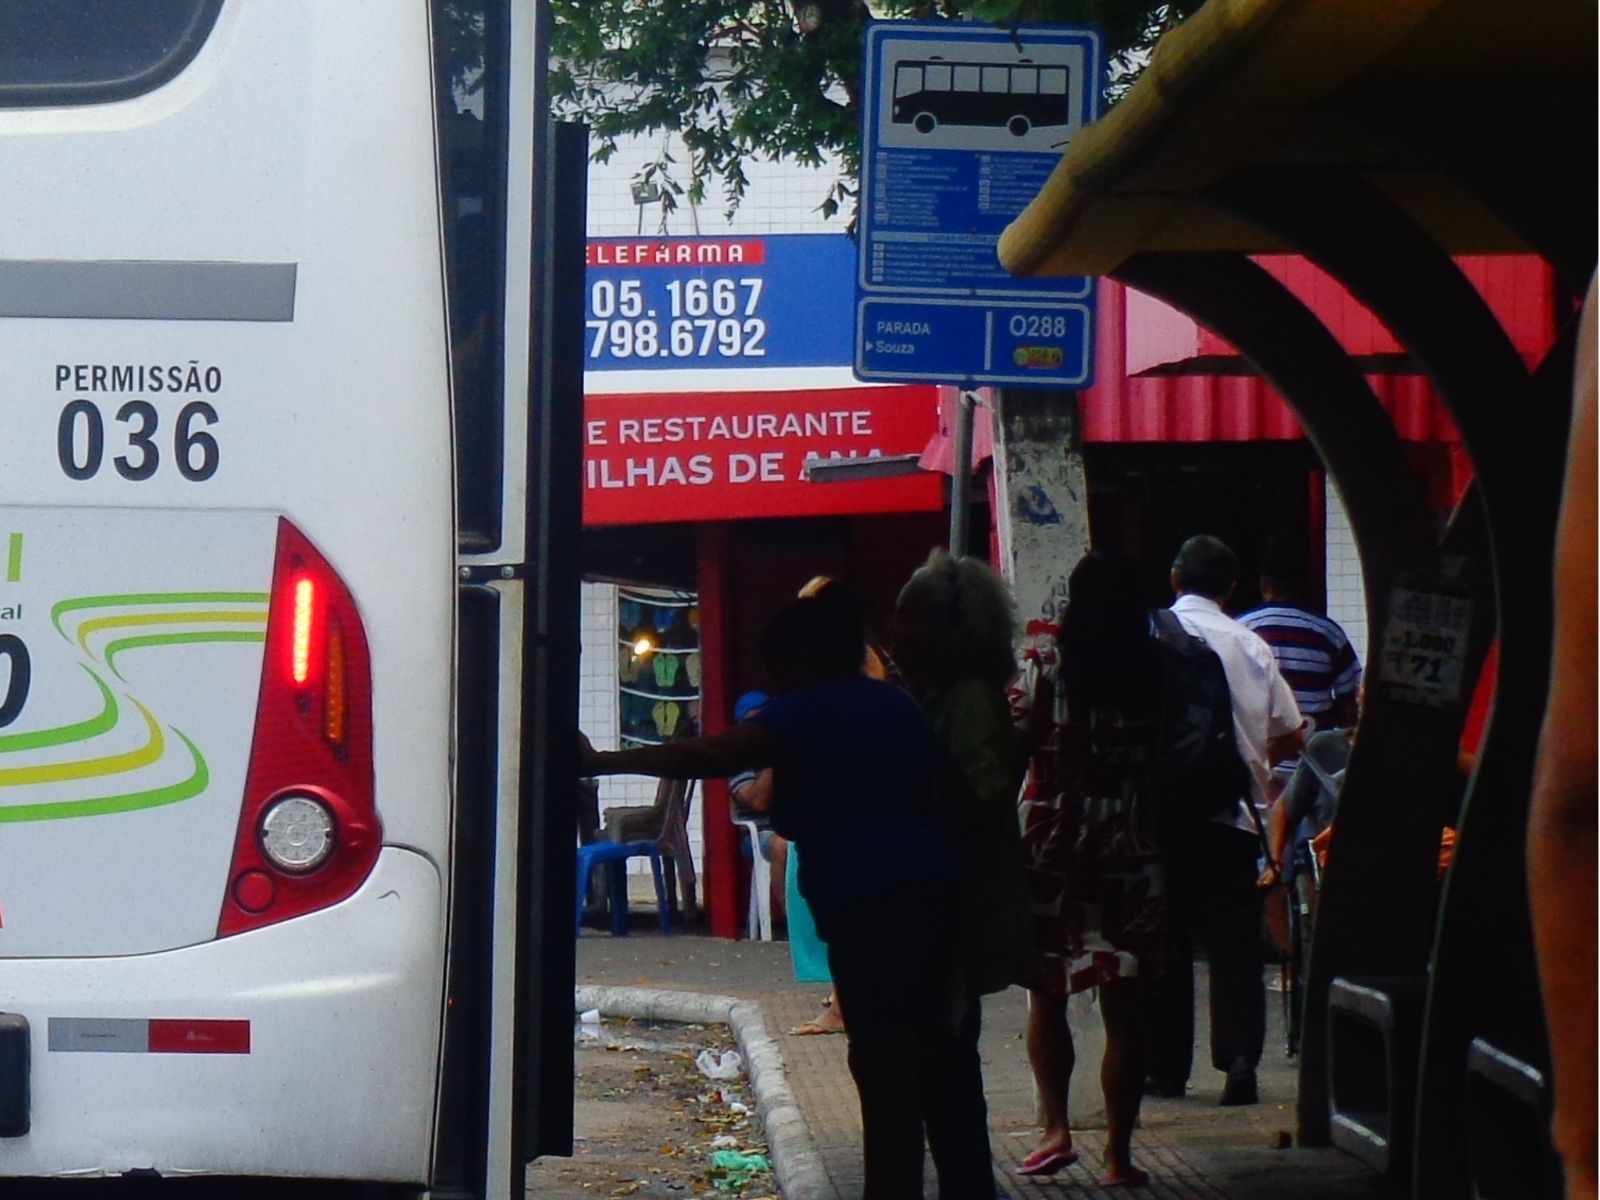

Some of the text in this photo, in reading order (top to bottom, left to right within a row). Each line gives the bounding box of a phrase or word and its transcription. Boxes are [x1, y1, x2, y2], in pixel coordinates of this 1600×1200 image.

[586, 319, 766, 358] 798.6792
[877, 321, 931, 335] PARADA
[876, 340, 915, 354] Souza
[56, 360, 221, 393] PERMISSÃO
[57, 399, 219, 482] 036
[588, 411, 872, 445] E RESTAURANTE
[587, 454, 714, 488] ILHAS
[729, 452, 785, 484] DE
